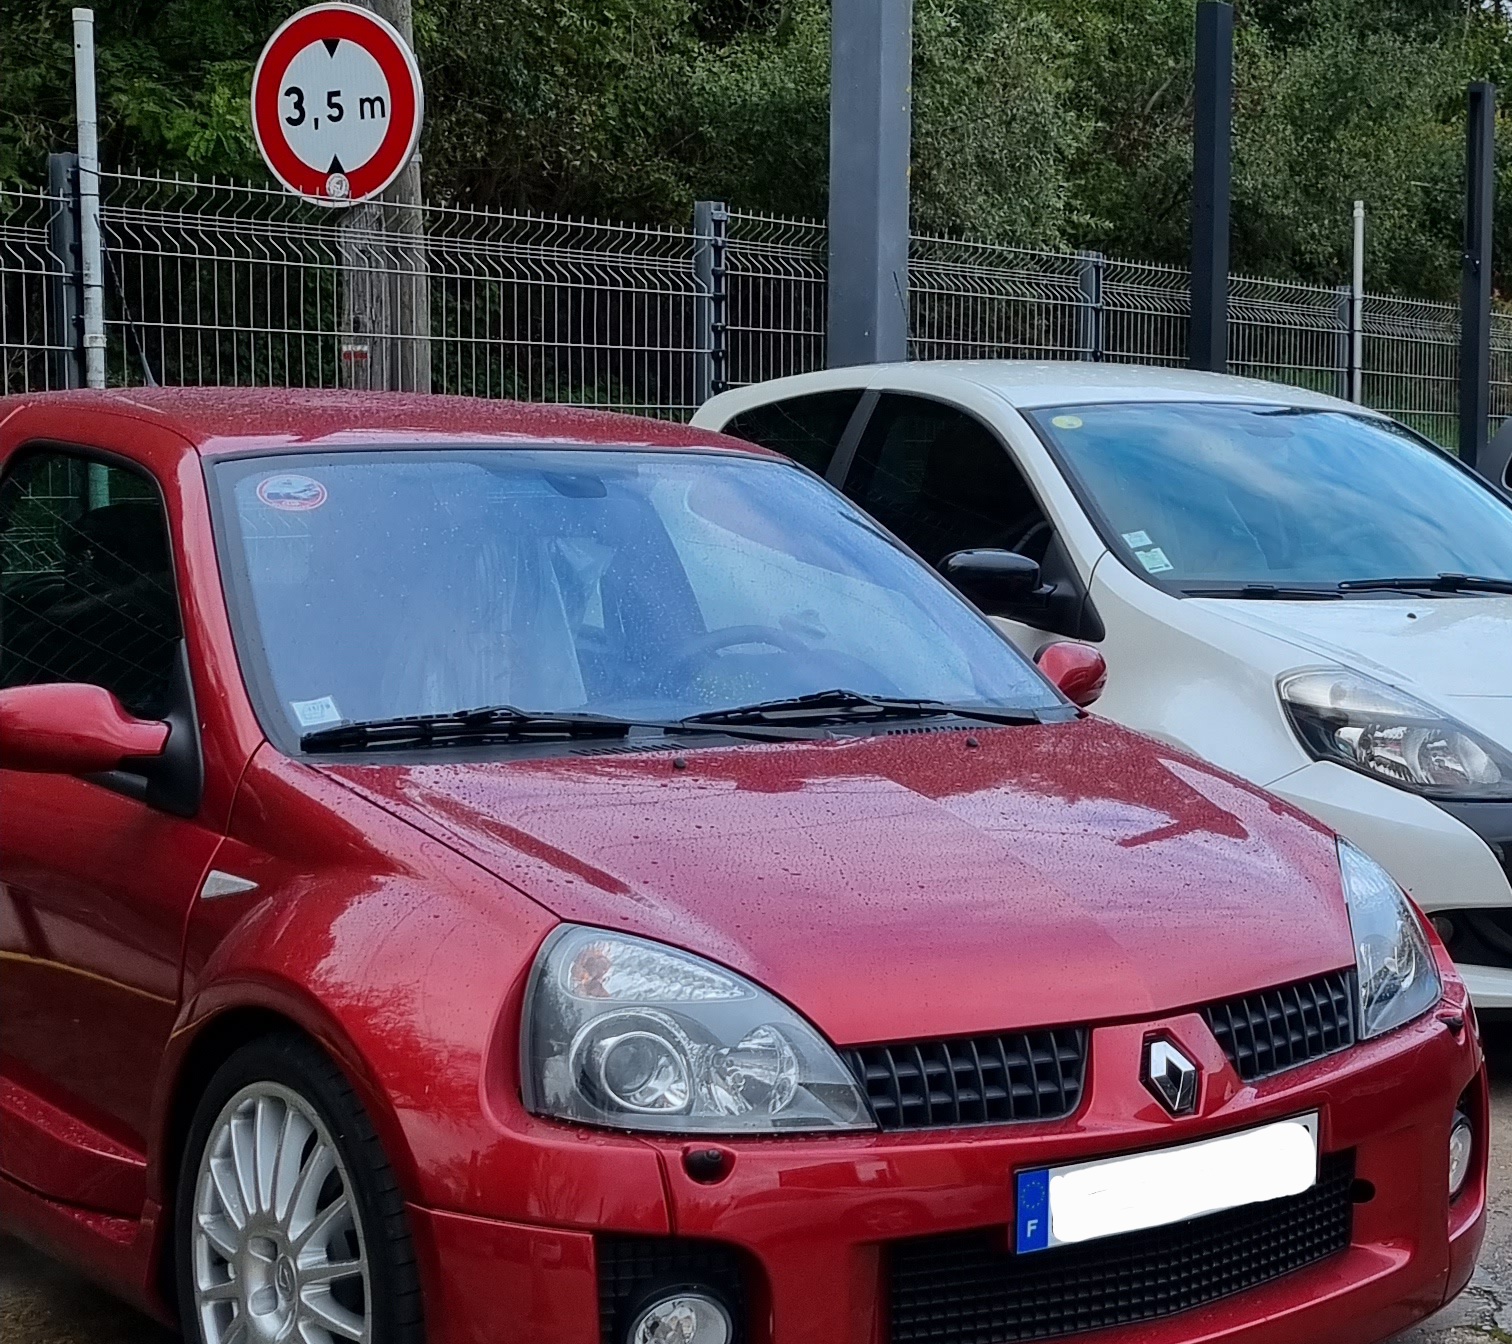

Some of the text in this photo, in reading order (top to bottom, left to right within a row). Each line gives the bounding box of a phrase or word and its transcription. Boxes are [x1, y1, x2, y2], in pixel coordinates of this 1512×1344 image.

[284, 86, 386, 130] 3,5 m
[1026, 1219, 1039, 1238] F
